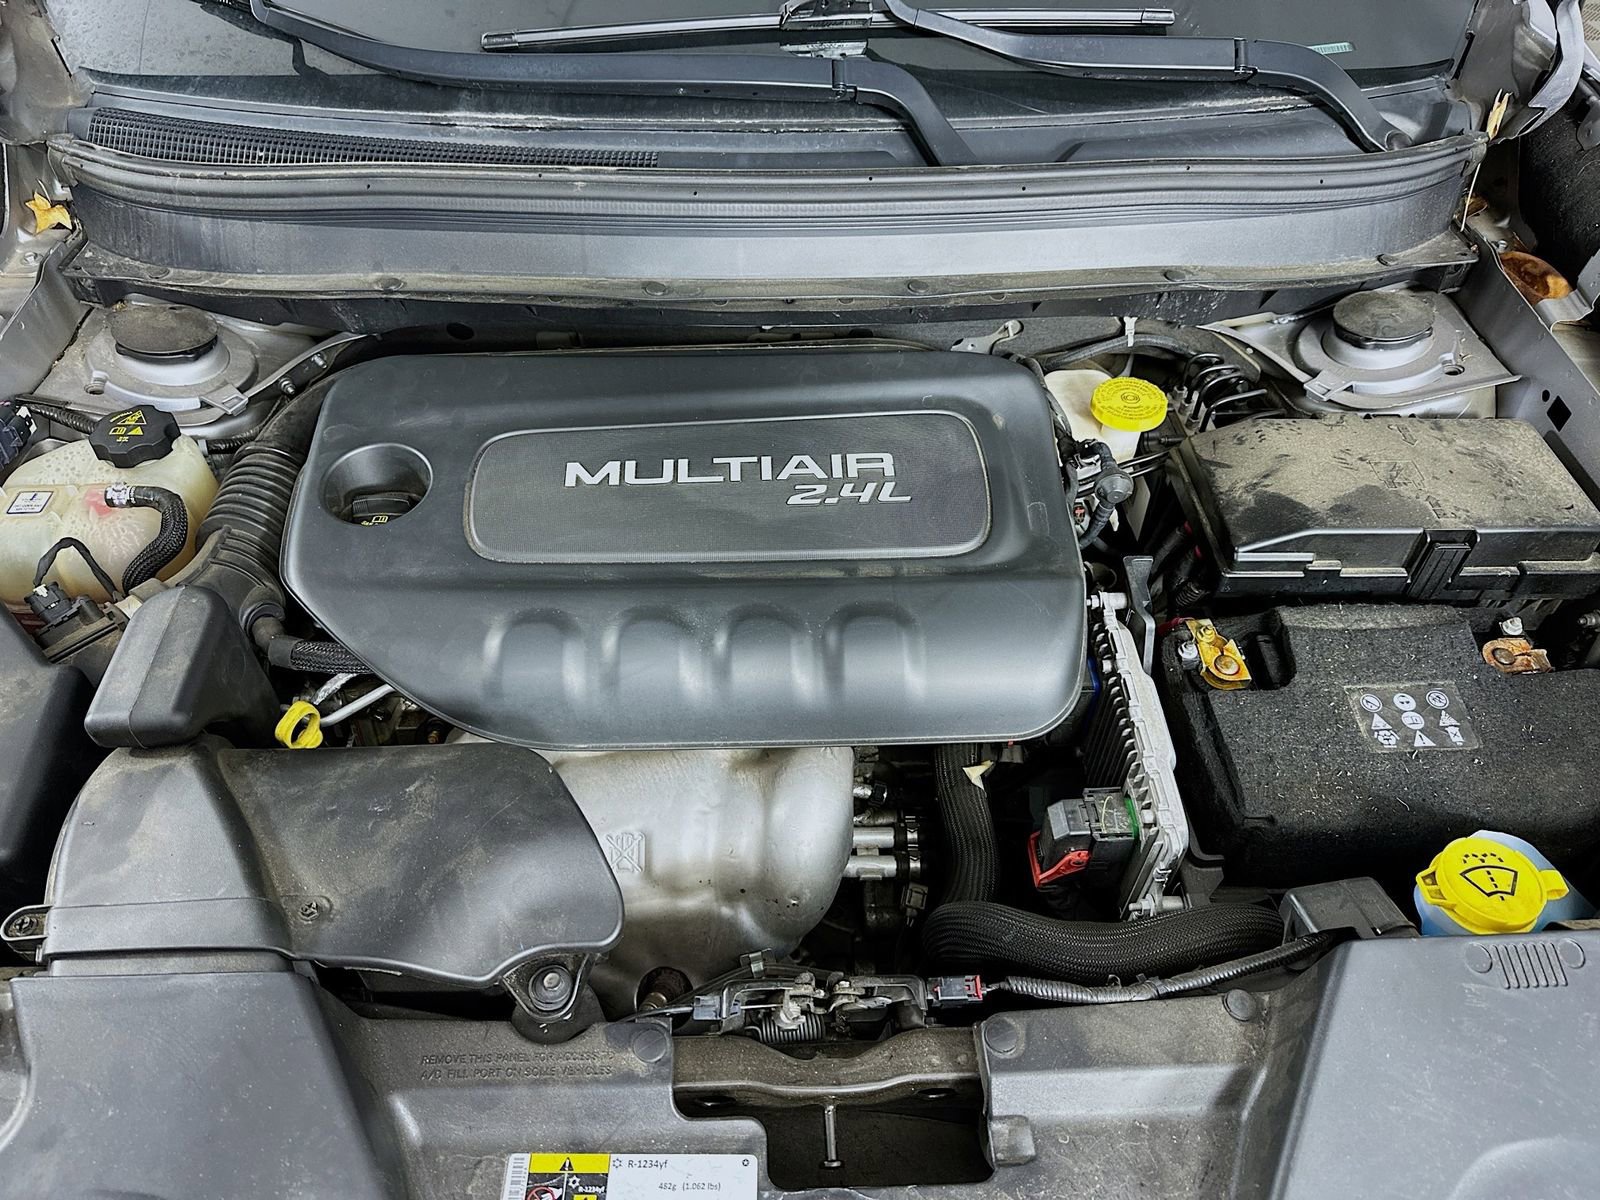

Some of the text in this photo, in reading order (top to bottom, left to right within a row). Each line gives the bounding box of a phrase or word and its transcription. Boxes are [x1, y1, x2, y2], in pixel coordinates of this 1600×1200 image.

[564, 452, 896, 487] MULTIAIR
[786, 481, 912, 506] 2.4L
[421, 1054, 467, 1065] REMOVE
[469, 1053, 493, 1063] THIS
[474, 1068, 502, 1078] PORT
[627, 1159, 668, 1170] R-1234yf
